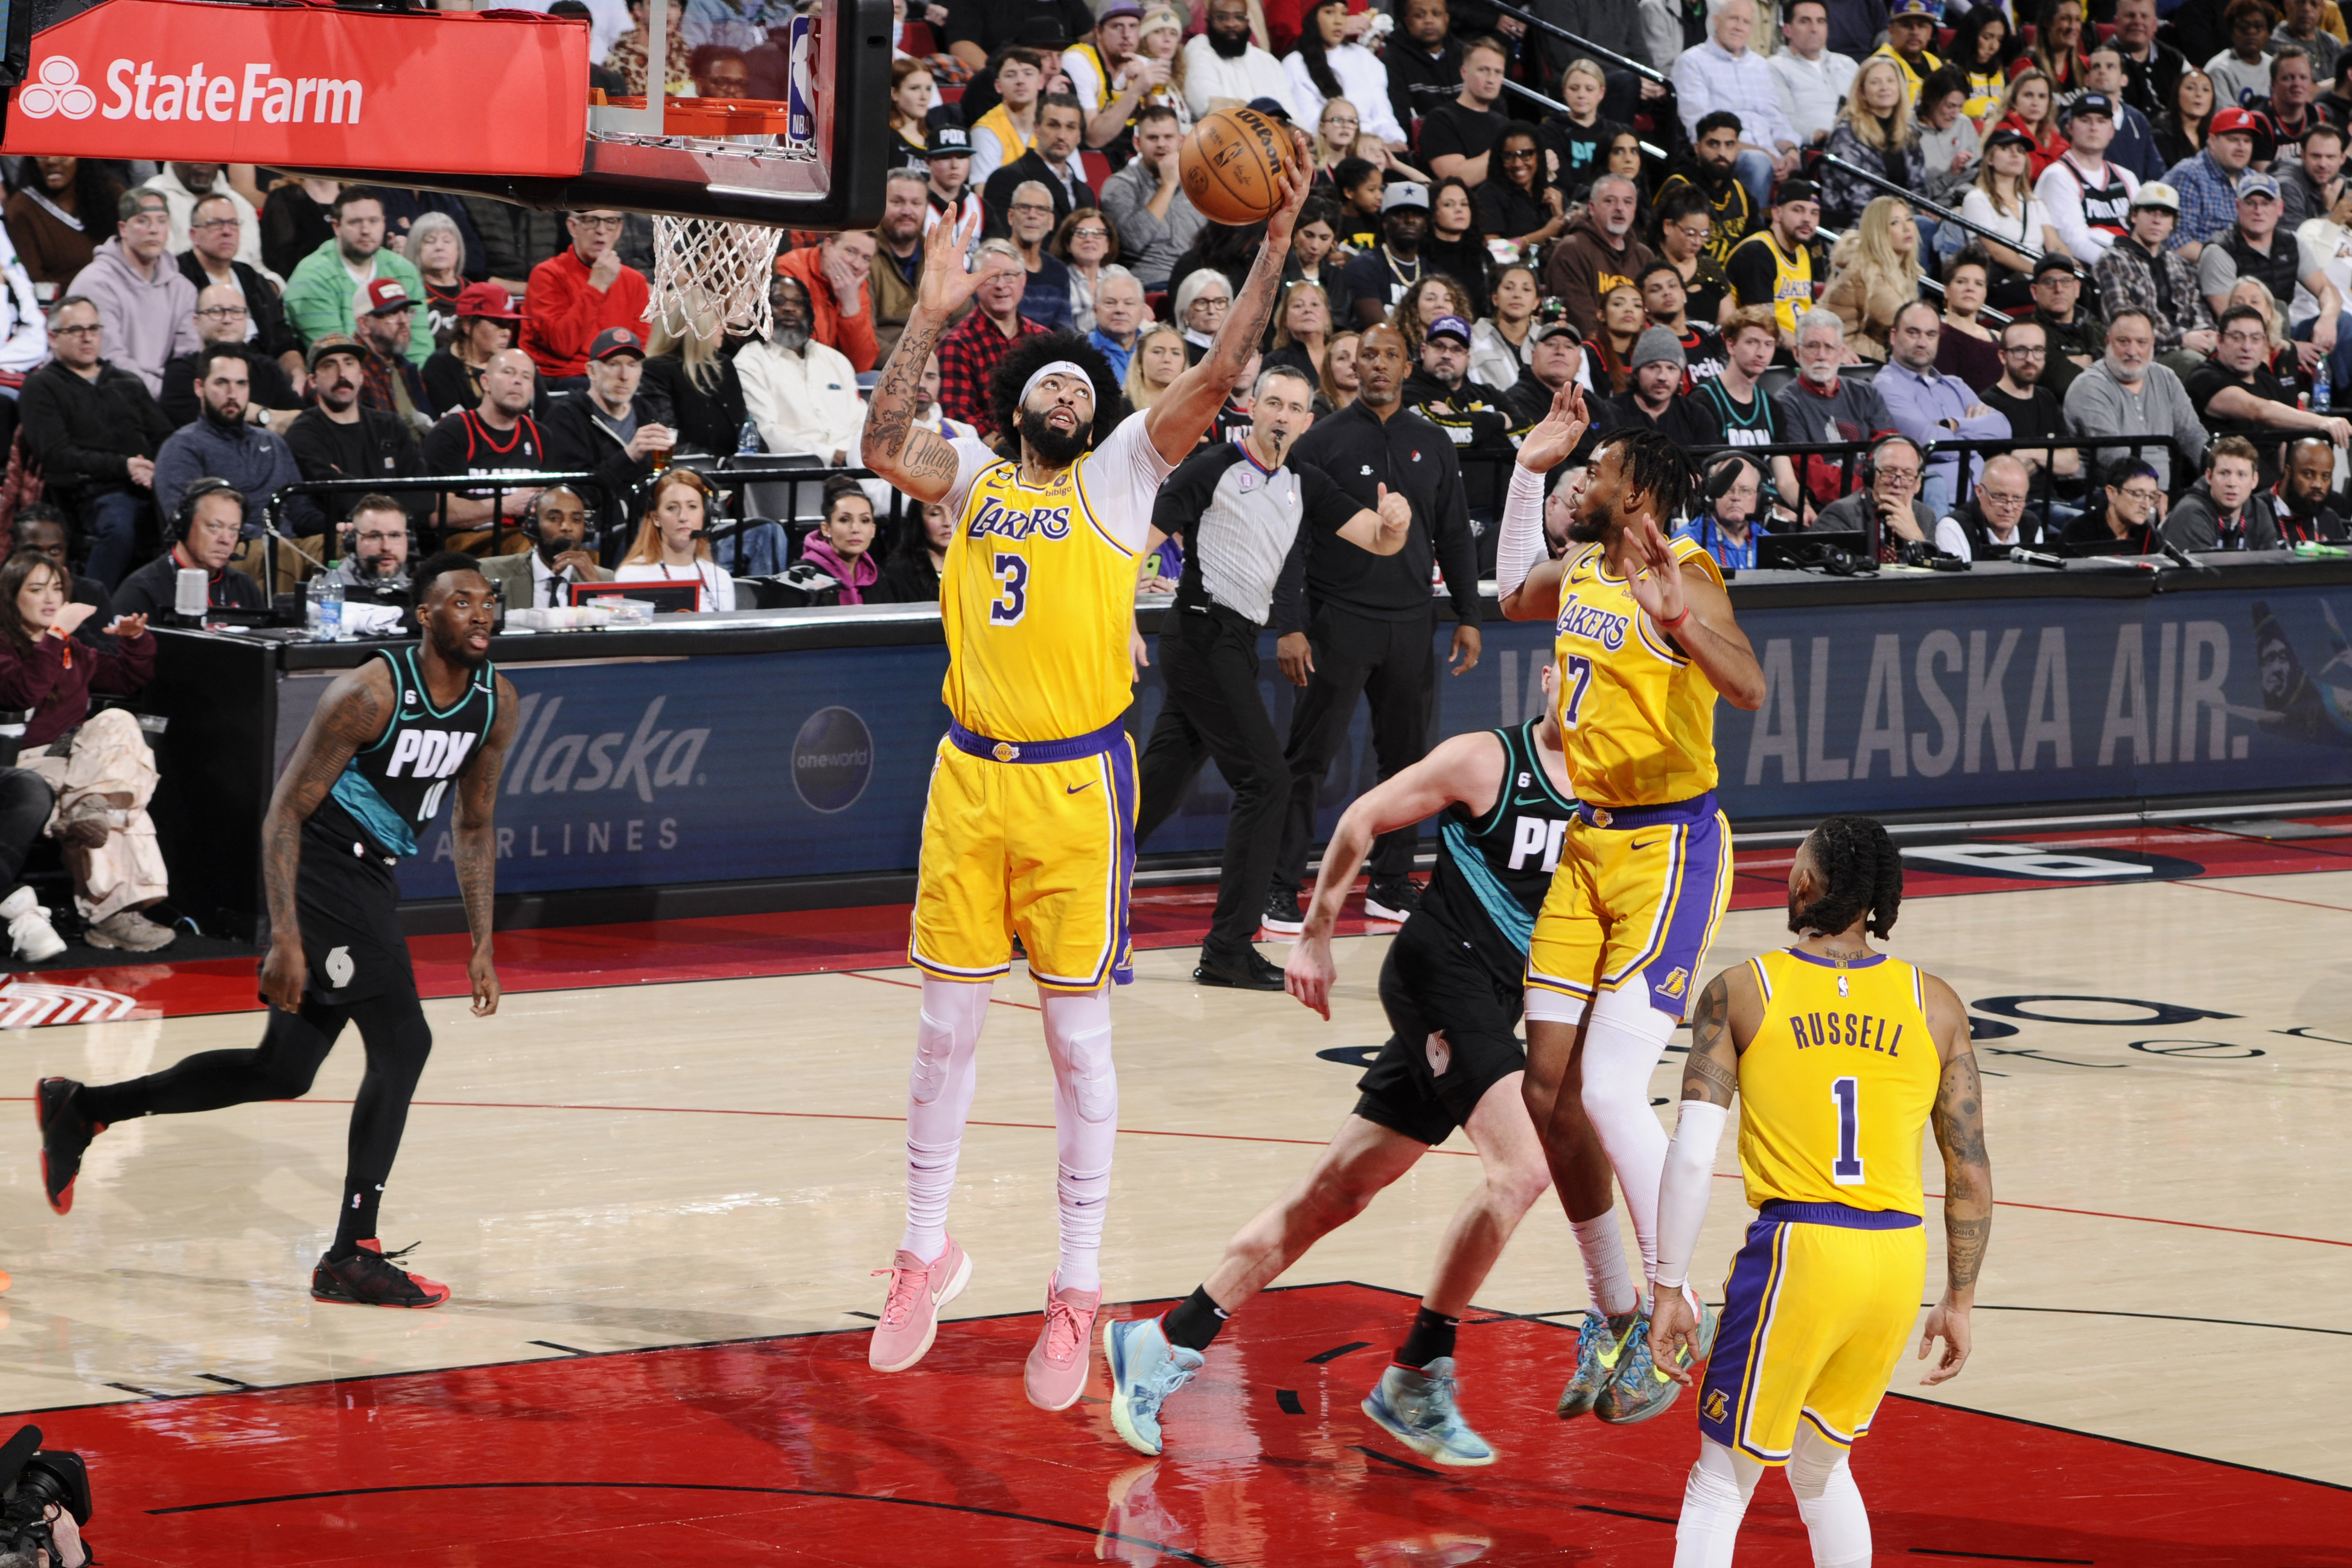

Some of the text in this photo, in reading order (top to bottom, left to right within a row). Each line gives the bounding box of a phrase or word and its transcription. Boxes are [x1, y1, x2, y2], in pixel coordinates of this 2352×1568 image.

[792, 113, 810, 135] NBA
[1045, 486, 1072, 497] bibigo
[989, 552, 1030, 627] 3
[1555, 592, 1631, 652] LAKERS
[404, 689, 417, 705] 6
[1564, 652, 1593, 730] 7
[1744, 620, 2249, 786] ALASKA AIR.
[386, 728, 477, 779] PDX
[797, 748, 868, 770] oneworld
[1518, 771, 1532, 788] 6
[432, 817, 679, 862] ARLINES
[1789, 1012, 1904, 1058] RUSSELL
[1831, 1076, 1866, 1186] 1
